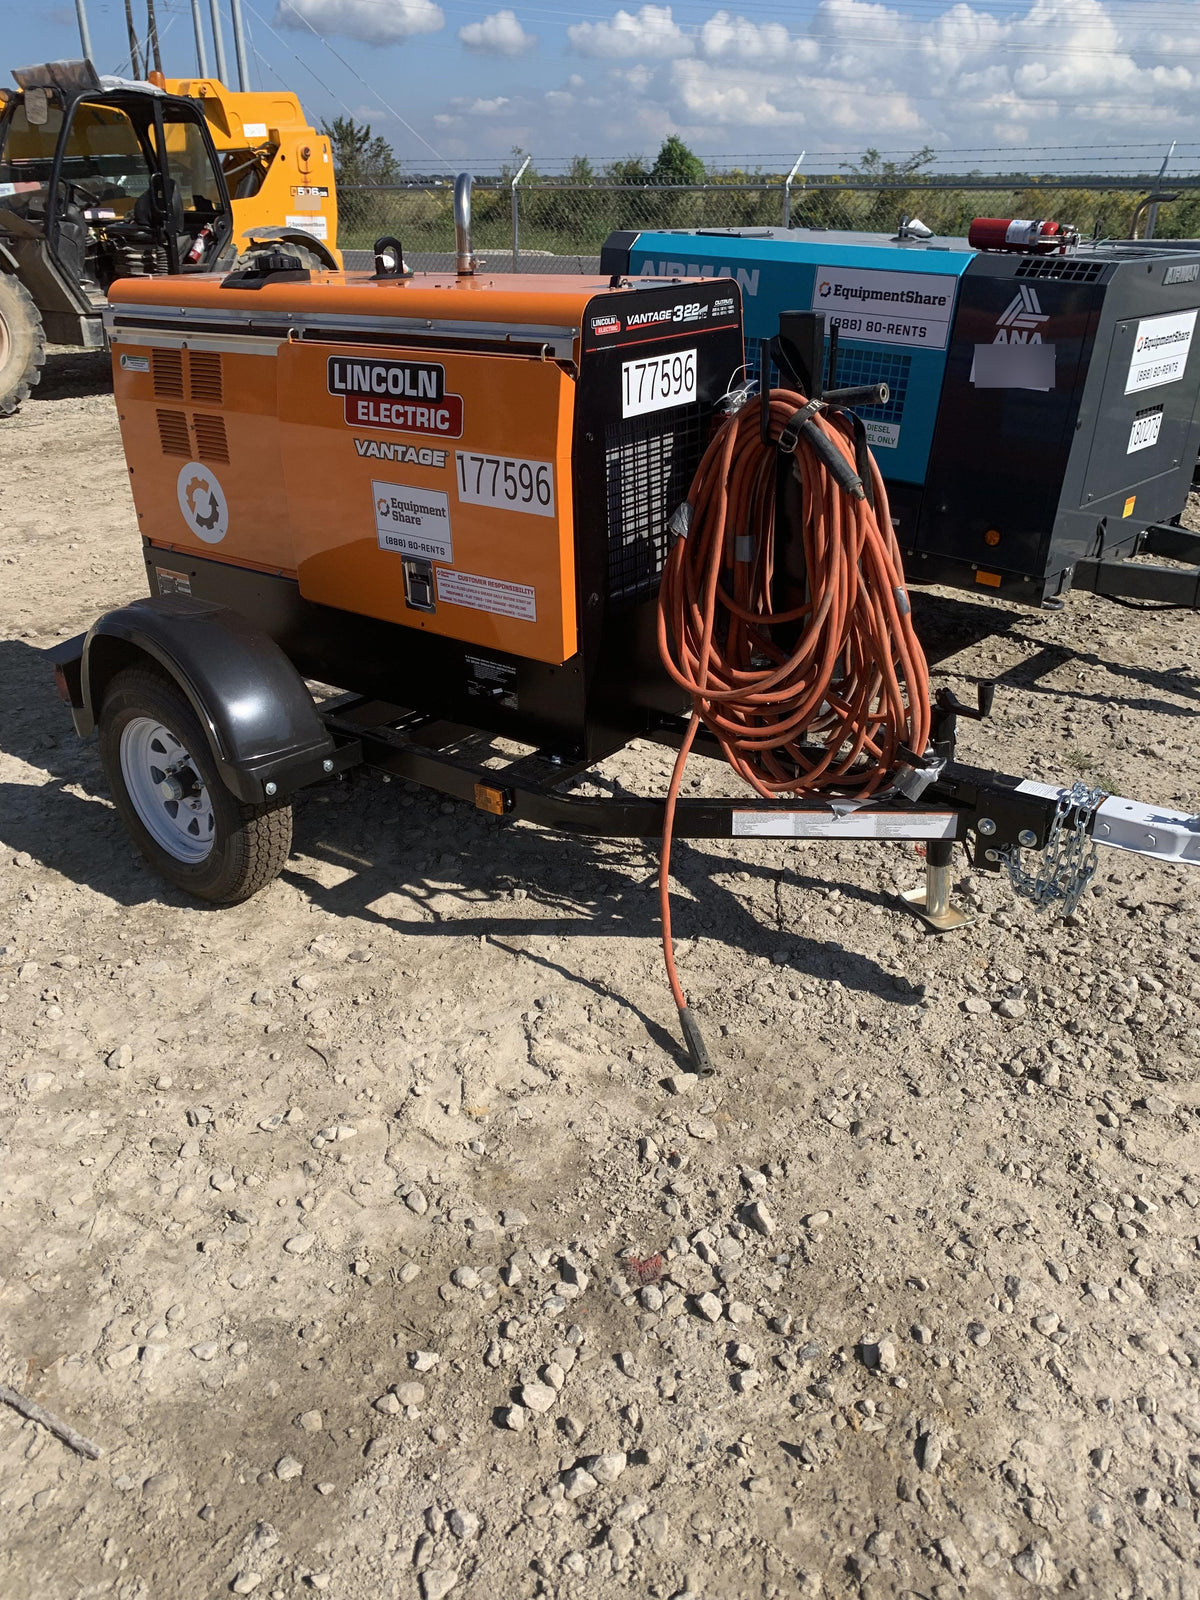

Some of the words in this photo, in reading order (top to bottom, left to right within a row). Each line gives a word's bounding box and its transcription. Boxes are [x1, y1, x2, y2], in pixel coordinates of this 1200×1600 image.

[833, 284, 947, 306] EquipmentShare
[592, 317, 616, 327] LINCOLN
[626, 309, 673, 326] VANTAGE
[673, 303, 701, 322] 322
[598, 325, 618, 334] ELECTRIC
[866, 321, 928, 338] 80-RENTS
[992, 329, 1043, 345] ANA
[1143, 331, 1190, 351] EquipmentShare
[334, 363, 437, 399] LINCOLN
[623, 354, 694, 406] 177596
[357, 401, 450, 430] ELECTRIC
[867, 424, 891, 433] DIESEL
[877, 436, 896, 445] ONLY
[353, 438, 446, 469] VANTAGE
[457, 454, 551, 506] 177596
[390, 498, 447, 518] Equipment
[392, 511, 422, 525] Share
[385, 536, 406, 548] (888)
[408, 541, 446, 556] 80-RENTS
